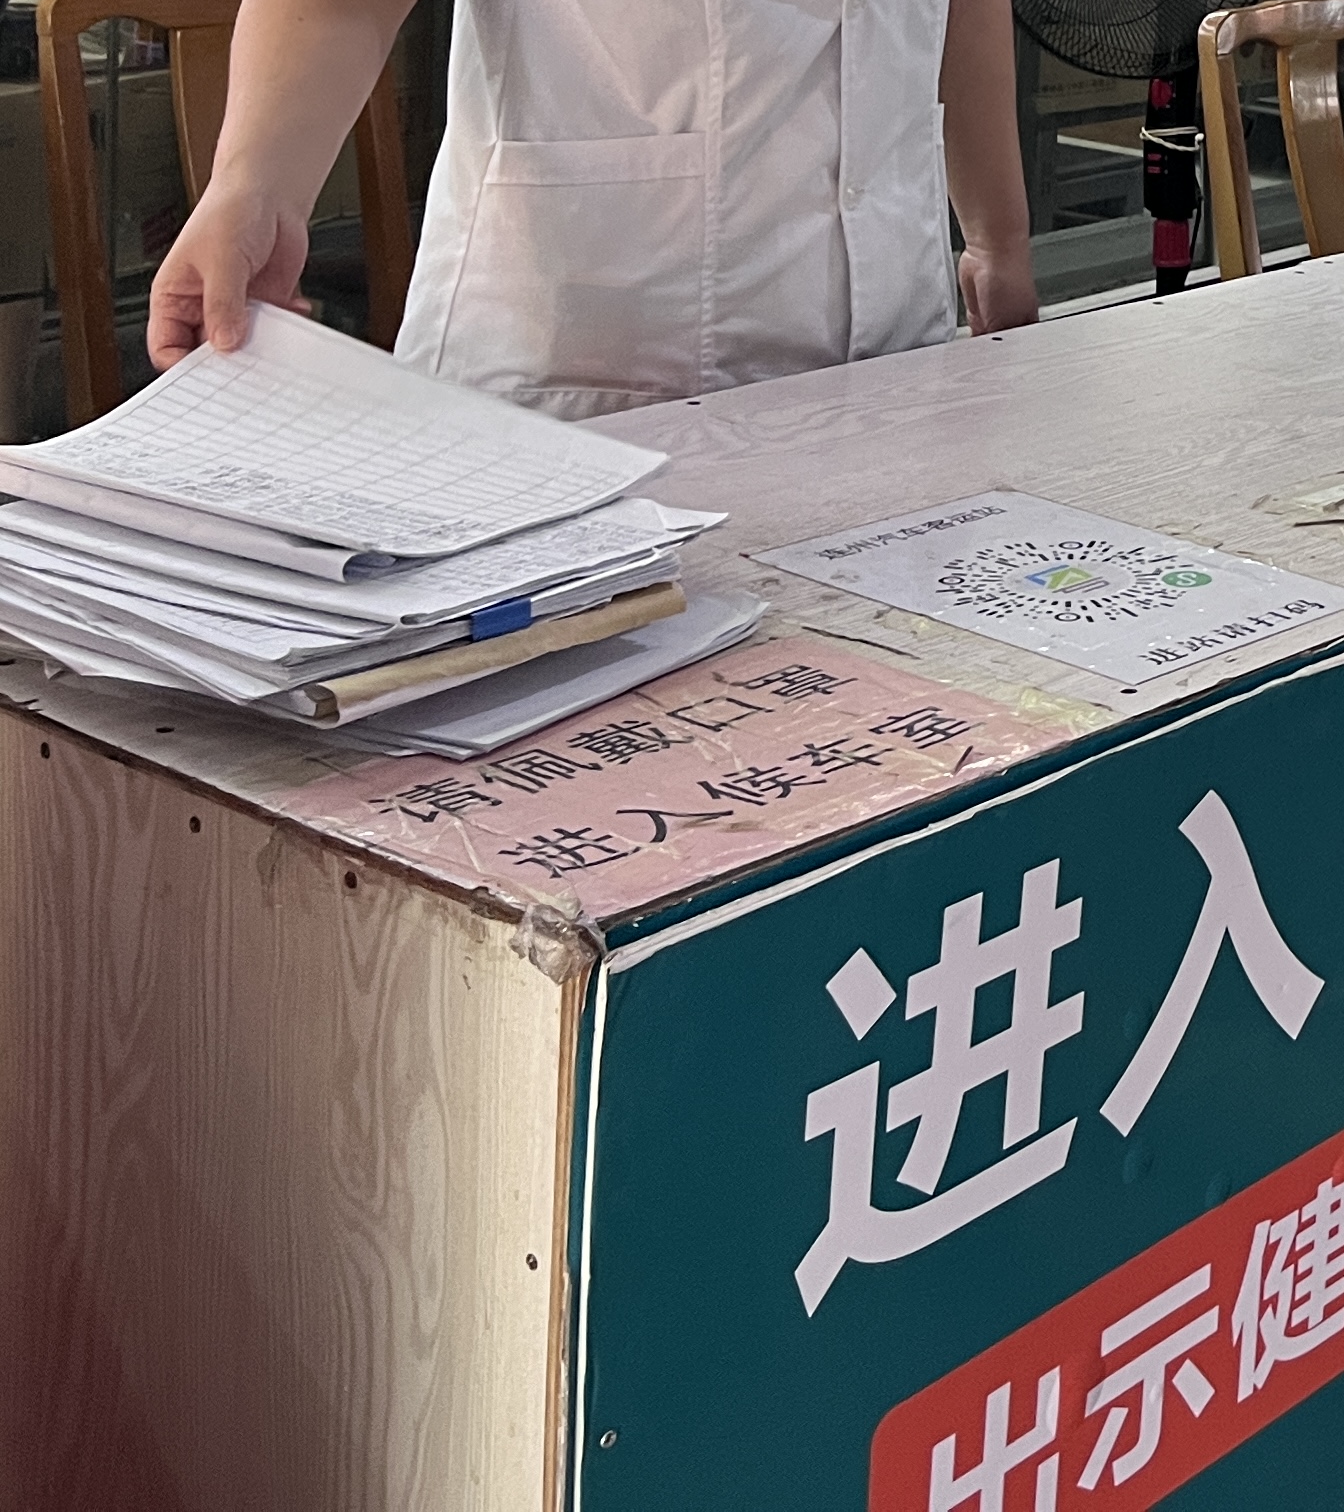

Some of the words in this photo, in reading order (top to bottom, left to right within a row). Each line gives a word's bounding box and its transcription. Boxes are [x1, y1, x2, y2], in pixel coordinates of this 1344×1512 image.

[370, 663, 859, 825] 请佩戴口罩
[499, 705, 970, 879] 进入候车室
